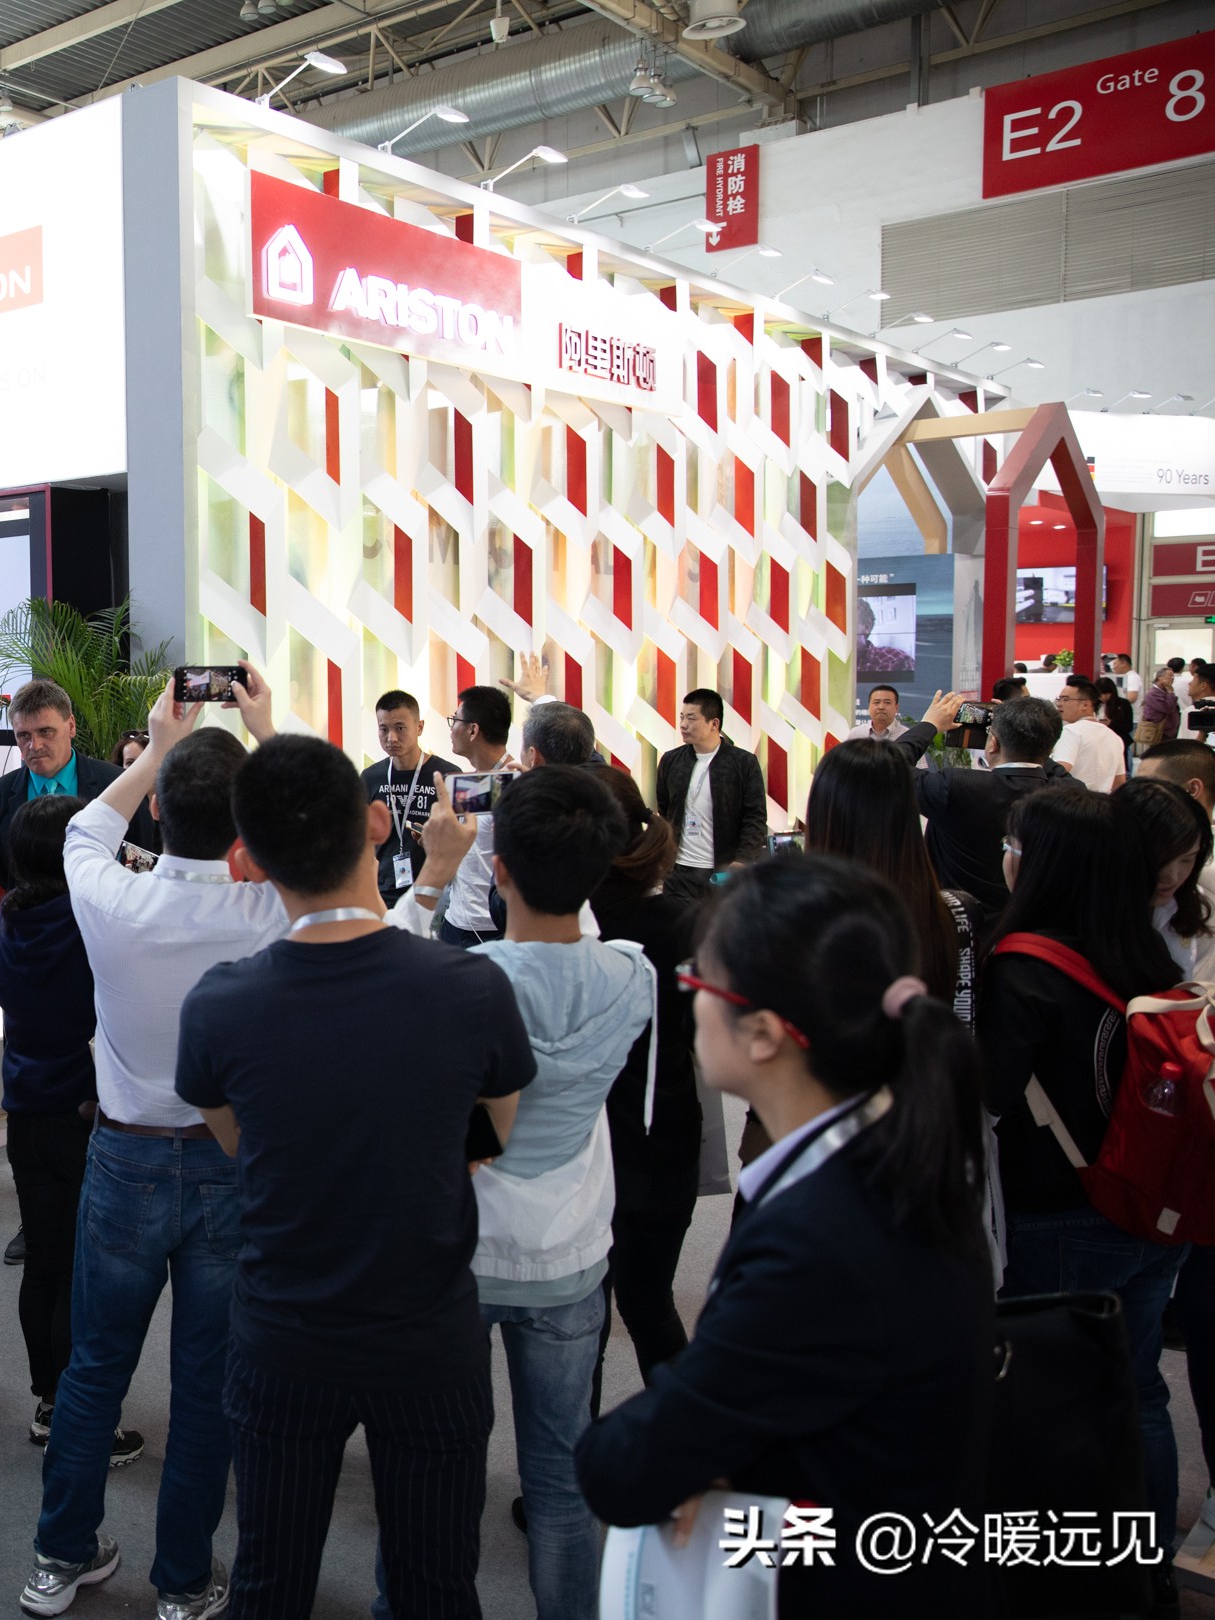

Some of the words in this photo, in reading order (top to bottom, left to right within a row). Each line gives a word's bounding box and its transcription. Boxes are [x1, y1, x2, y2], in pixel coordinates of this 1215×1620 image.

[1095, 67, 1160, 95] Gate
[1164, 68, 1206, 123] 8
[1002, 99, 1084, 162] E2
[716, 157, 724, 176] FIRE
[726, 152, 746, 216] 消防栓
[715, 177, 724, 218] HYDRANT
[328, 266, 515, 356] ARISTON
[558, 322, 657, 392] 阿里斯顿
[1156, 468, 1173, 485] 90
[1175, 468, 1210, 485] Years
[378, 784, 409, 793] ARMANI
[414, 784, 436, 796] EANS
[417, 795, 428, 810] 81
[951, 907, 969, 933] LIFE
[957, 947, 971, 987] SHAPE
